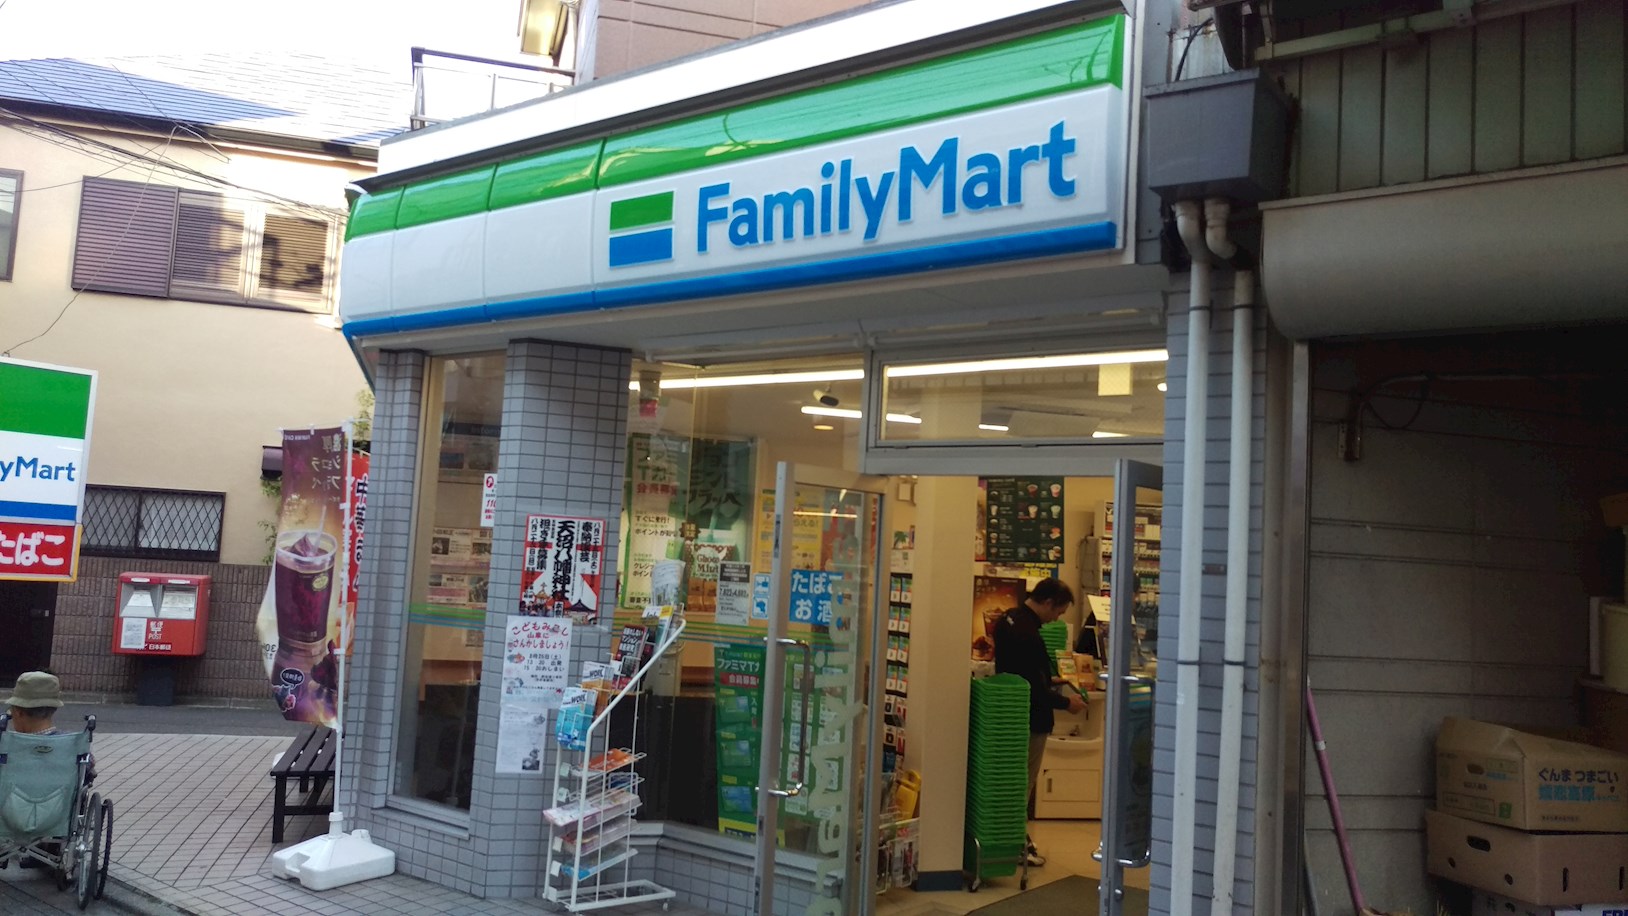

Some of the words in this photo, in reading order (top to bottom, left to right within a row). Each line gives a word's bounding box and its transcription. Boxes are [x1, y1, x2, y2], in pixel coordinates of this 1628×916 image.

[697, 120, 1077, 255] FamilyMart
[1538, 767, 1572, 783] ぐんま
[1574, 768, 1619, 784] つまごい
